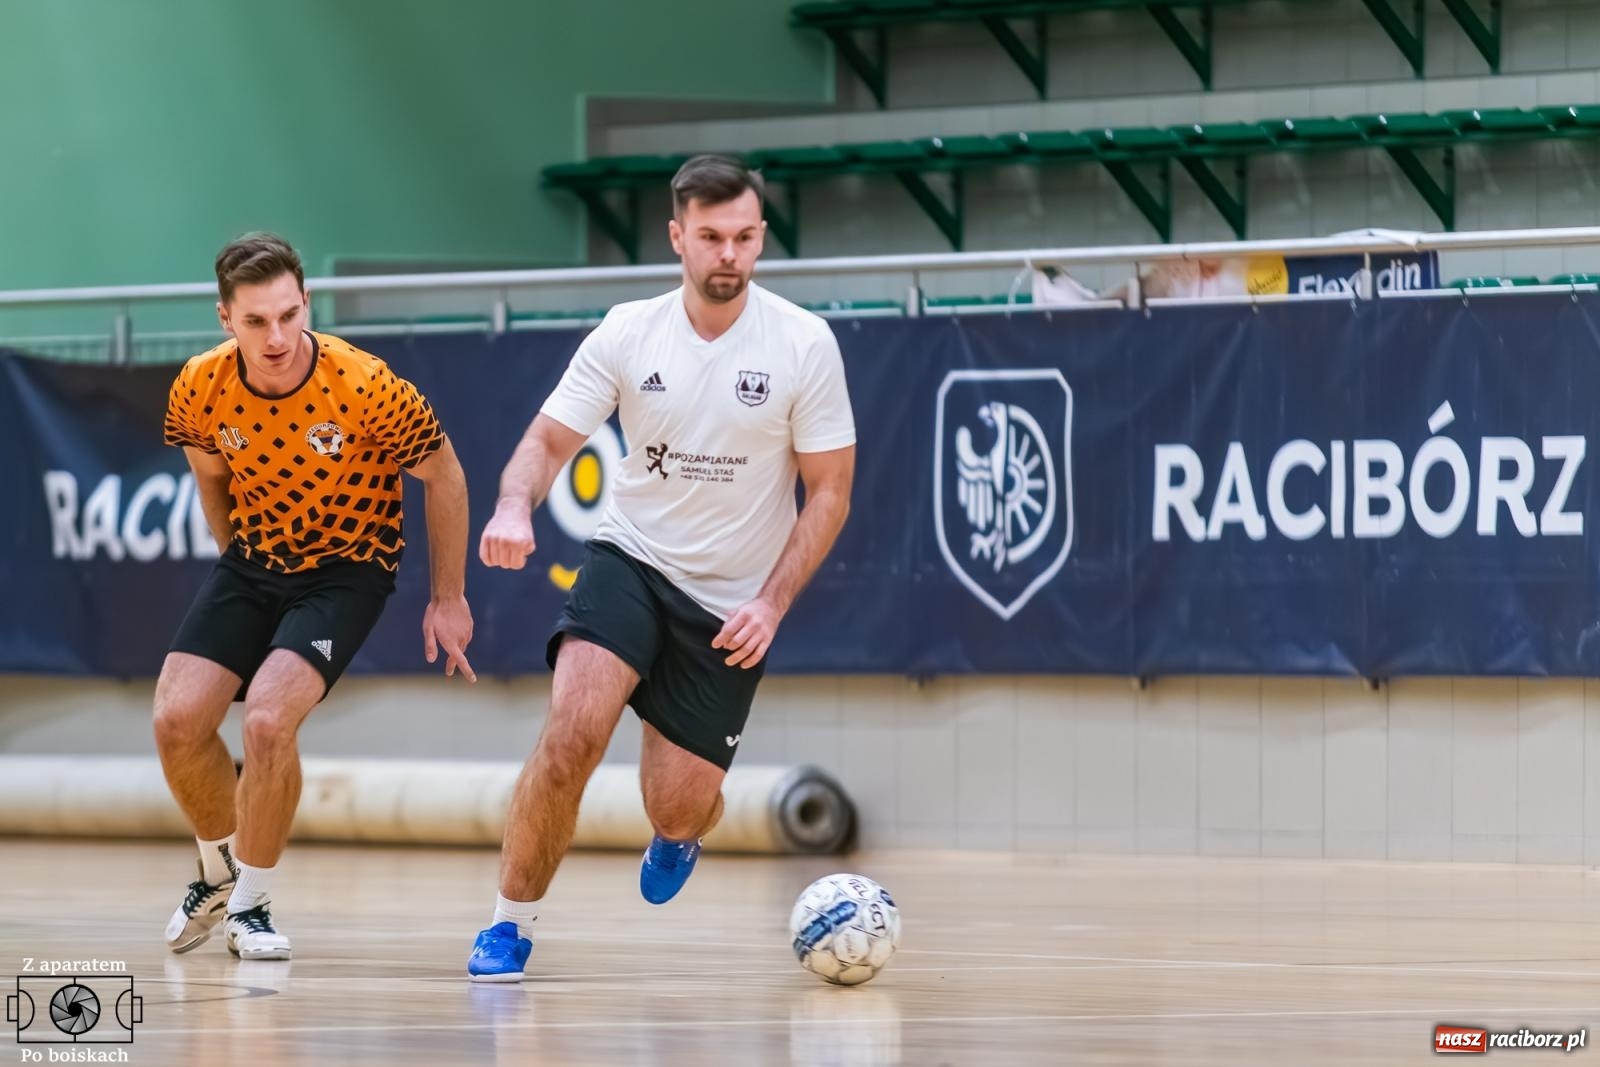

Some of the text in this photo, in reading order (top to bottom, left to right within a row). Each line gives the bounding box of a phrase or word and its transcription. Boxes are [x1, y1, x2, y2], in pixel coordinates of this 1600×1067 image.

[640, 384, 666, 392] adidas
[668, 452, 749, 465] #POZAMIATANE
[681, 466, 711, 476] SAMUEL
[1152, 400, 1586, 542] RACIBÓRZ
